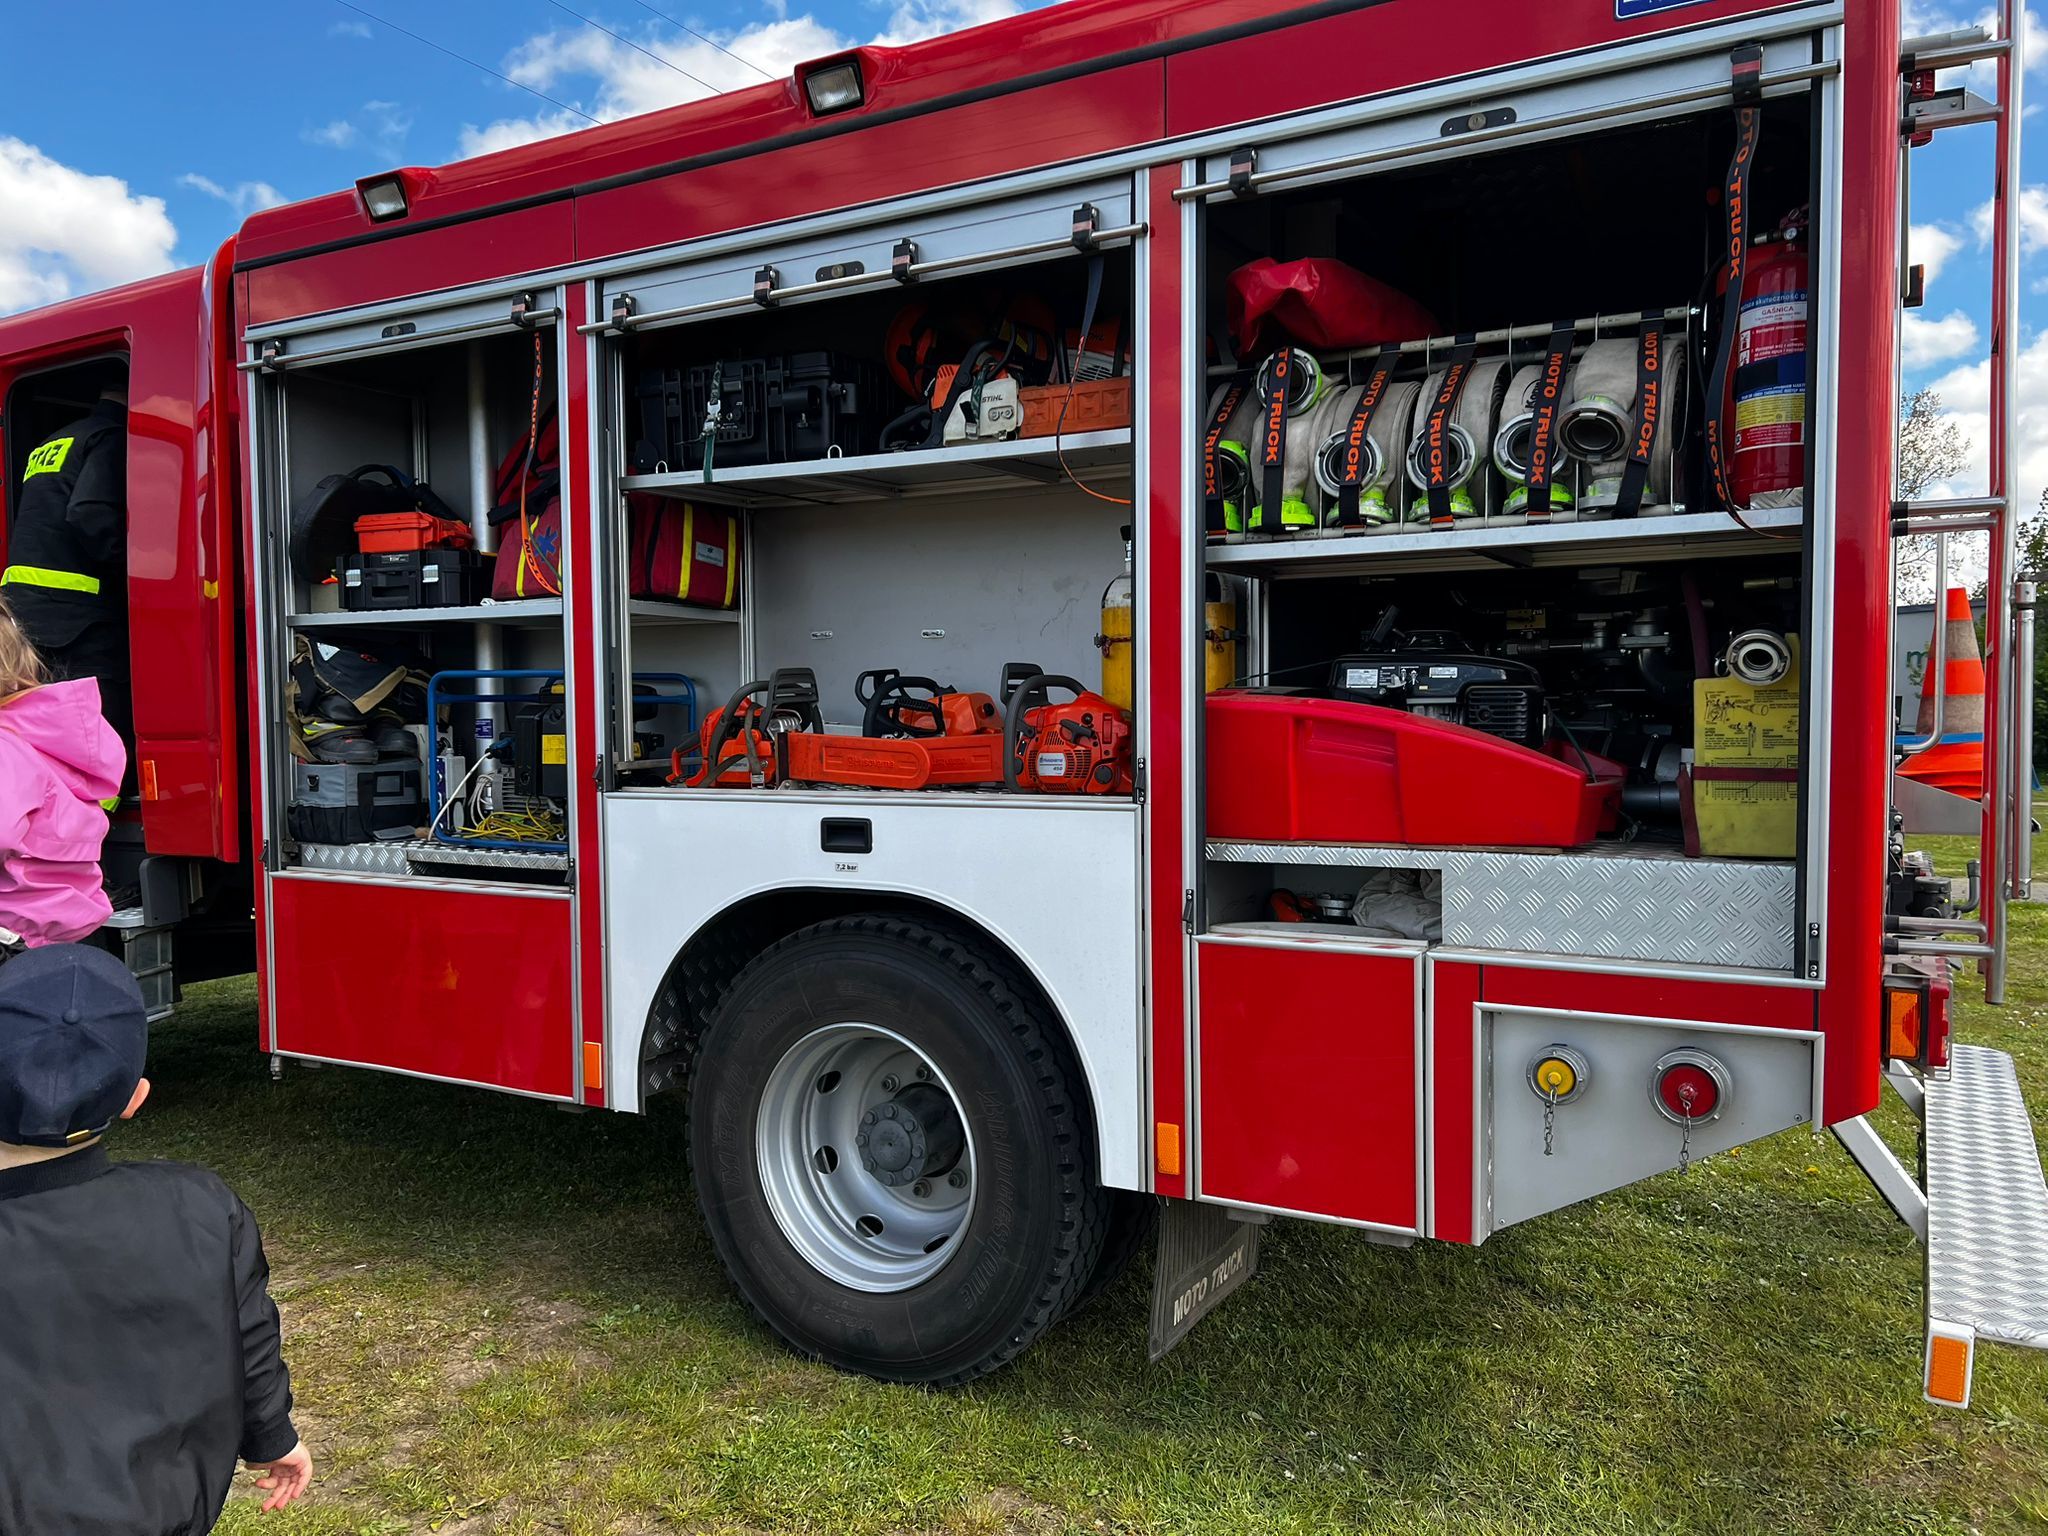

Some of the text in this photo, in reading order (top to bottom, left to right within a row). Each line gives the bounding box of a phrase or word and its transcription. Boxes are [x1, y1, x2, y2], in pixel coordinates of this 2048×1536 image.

[1730, 107, 1753, 280] OTO-TRUCK
[1761, 304, 1794, 315] GAŚNICA
[982, 394, 1003, 403] STIHL
[1205, 388, 1241, 496] MOTO TRUCK
[1265, 347, 1289, 463] TO TRUCK
[1345, 369, 1386, 480] MOTO TRUCK
[1430, 364, 1463, 484] MOTO TRUCK
[1530, 353, 1563, 484] MOTO TRUCK
[1636, 331, 1658, 458] MOTO TRUCK
[1708, 420, 1726, 501] MOTO
[1173, 1245, 1244, 1326] MOTO TRUCK
